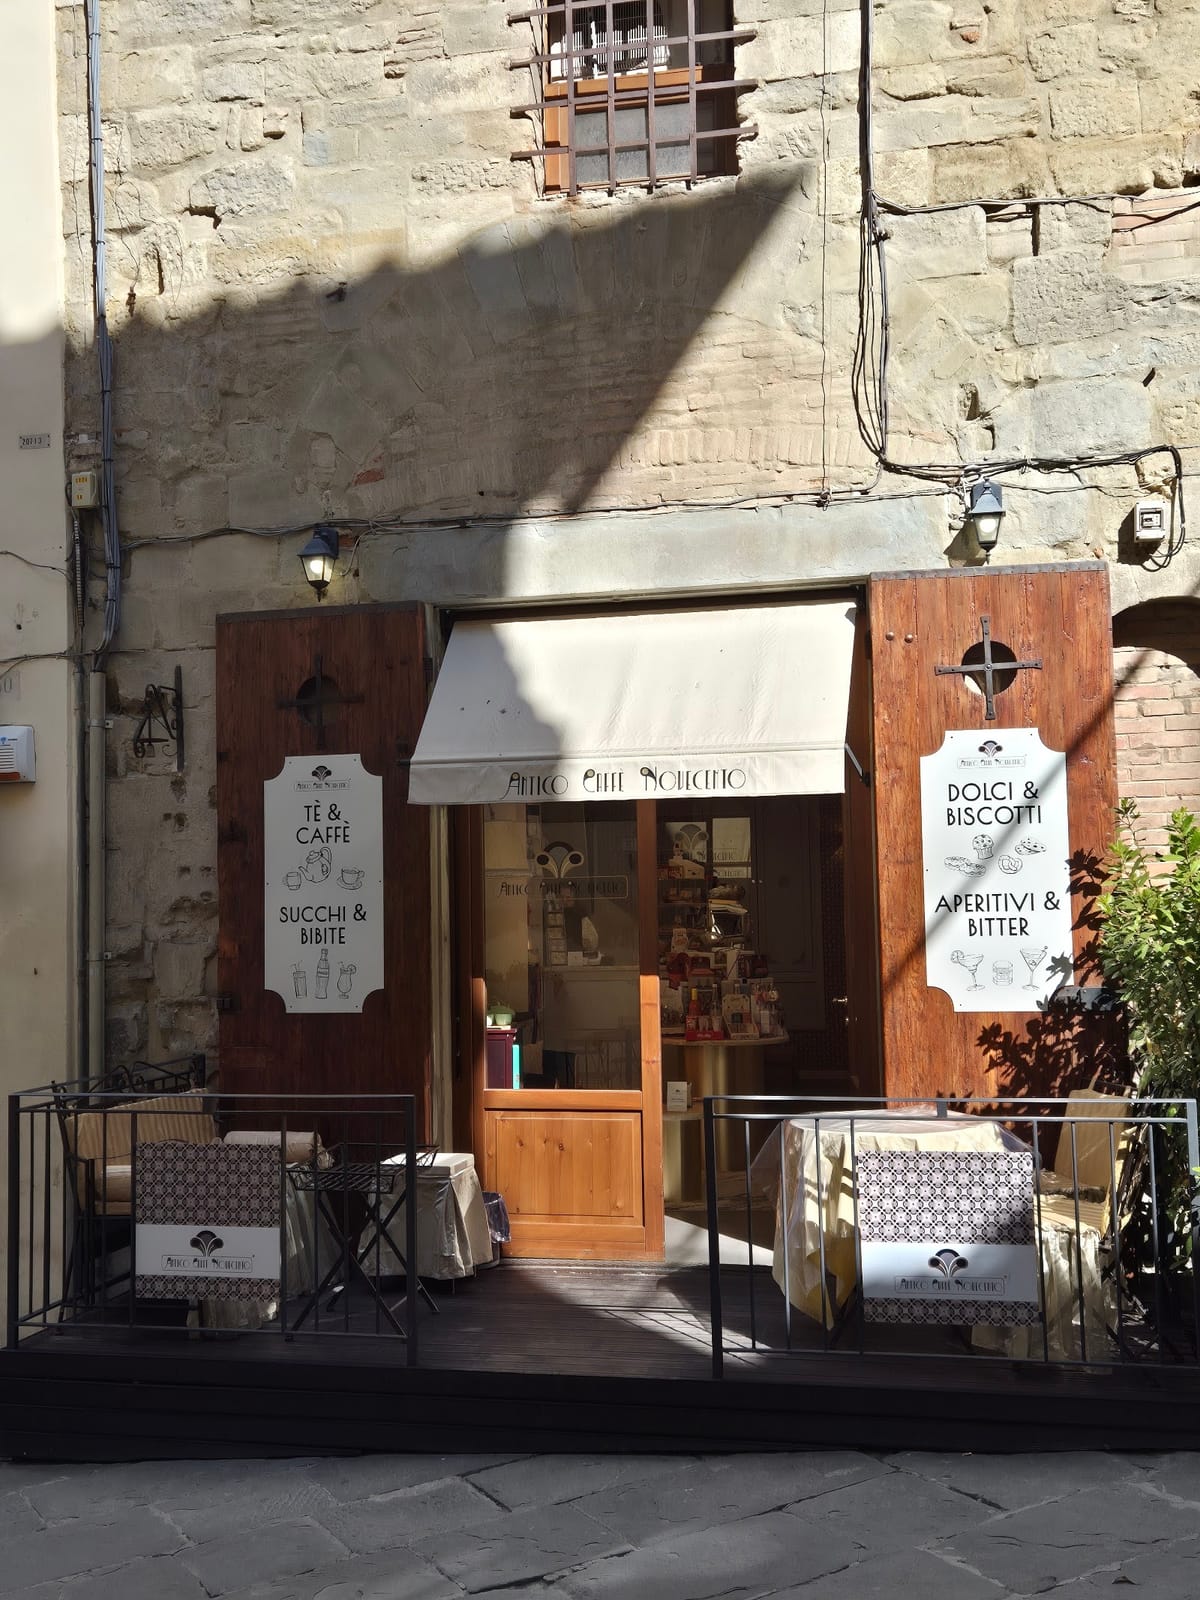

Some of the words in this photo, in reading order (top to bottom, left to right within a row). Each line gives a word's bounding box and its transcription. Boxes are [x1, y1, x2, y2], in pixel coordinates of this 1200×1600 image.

[948, 782, 1012, 802] DOLCI
[1023, 781, 1039, 799] &
[303, 799, 321, 822] TÈ
[327, 803, 341, 821] &
[946, 805, 1041, 826] BISCOTTI
[296, 820, 350, 845] CAFFÈ
[935, 892, 1034, 913] APERITIVI
[1043, 891, 1060, 911] &
[279, 905, 346, 923] SUCCHI
[353, 903, 367, 921] &
[300, 927, 346, 945] BIBITE
[968, 917, 1030, 937] BITTER
